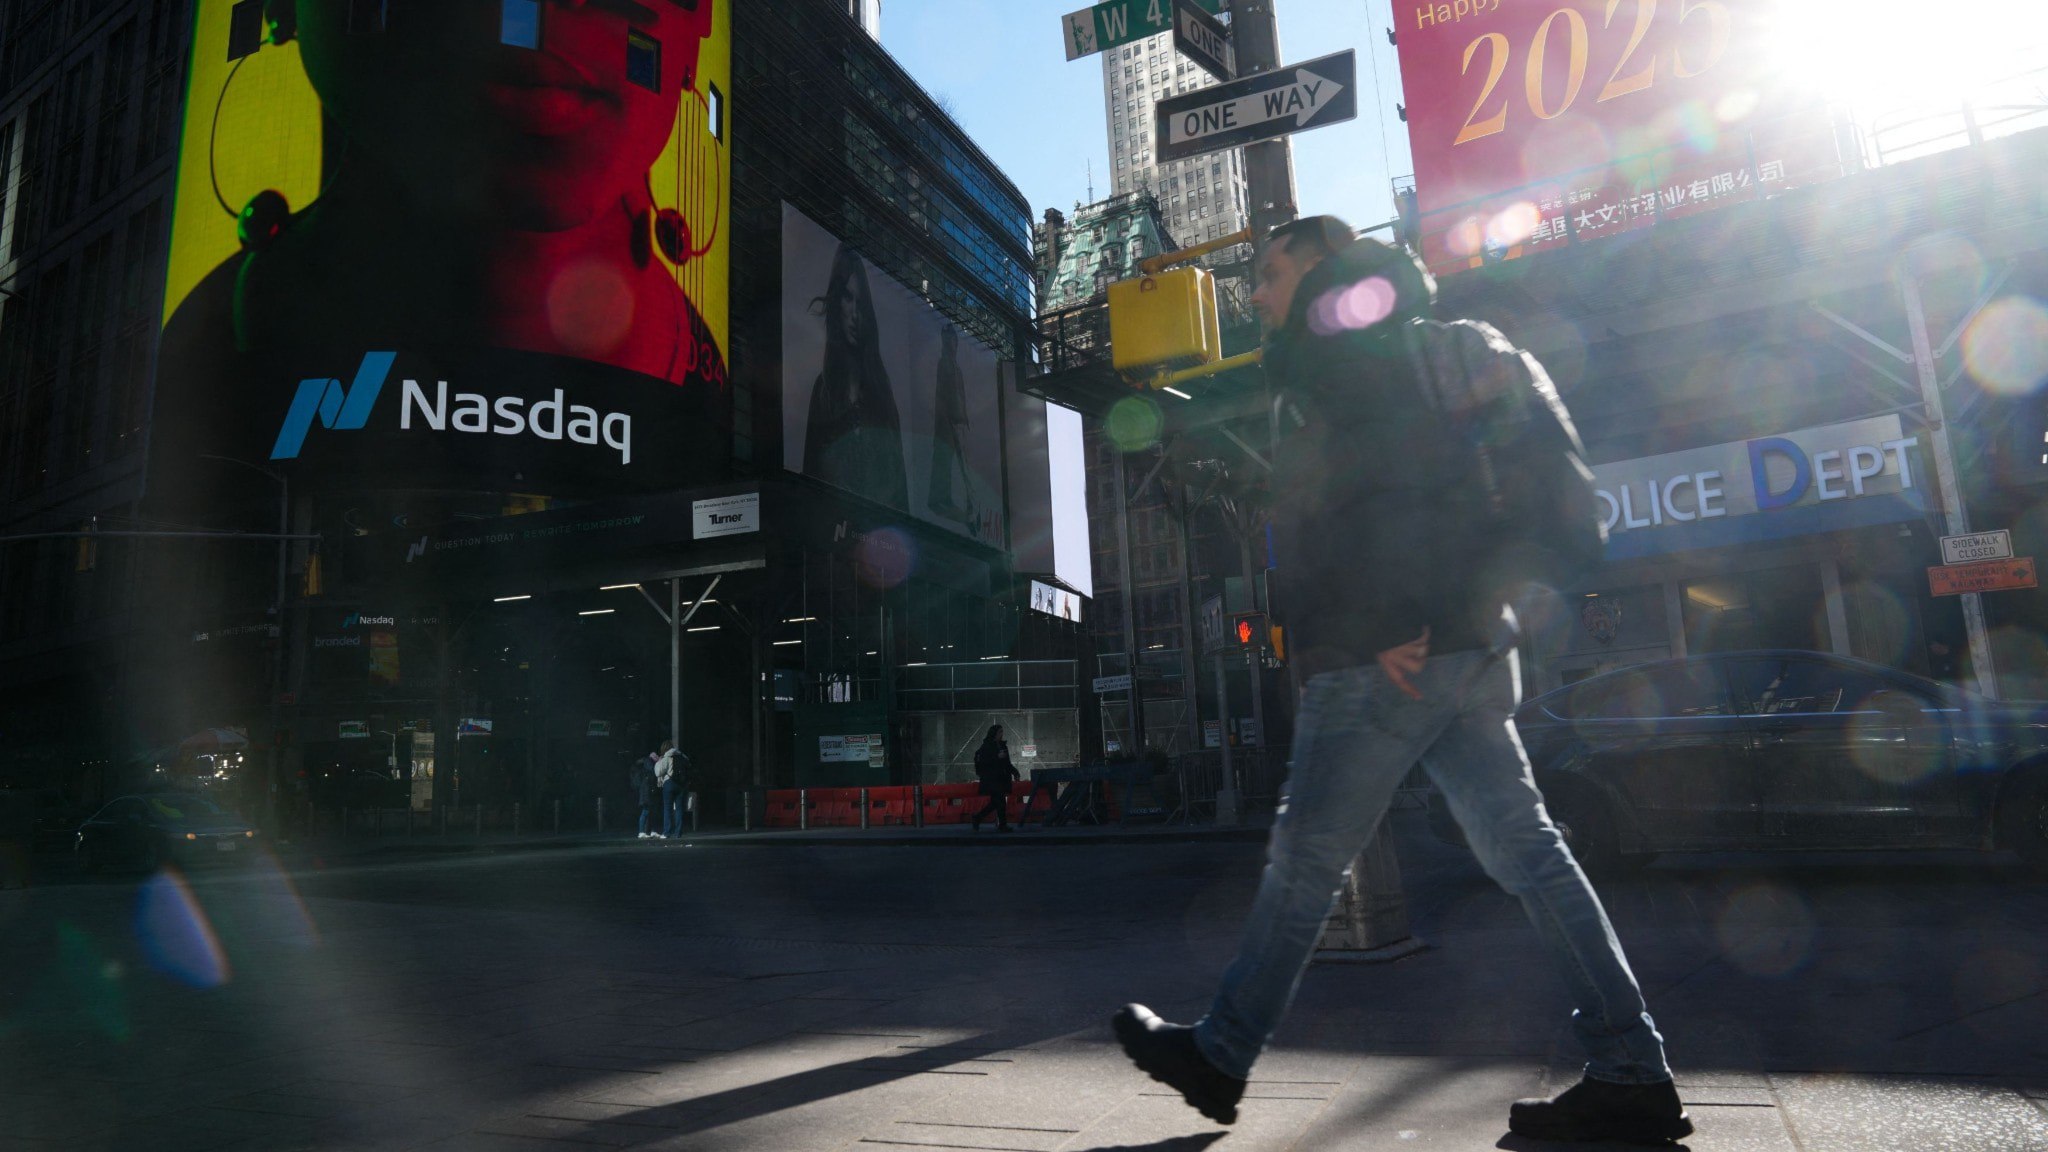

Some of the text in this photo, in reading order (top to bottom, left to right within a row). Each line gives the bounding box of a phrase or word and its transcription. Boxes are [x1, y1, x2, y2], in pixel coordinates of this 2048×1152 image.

[1101, 0, 1173, 42] W 4
[1190, 21, 1222, 59] ONE
[1453, 0, 1731, 145] 2025
[1184, 80, 1322, 137] ONE WAY
[401, 379, 631, 465] Nasdaq
[1595, 437, 1919, 530] OLICE DEPT
[434, 516, 642, 550] QUESTION TODAY REWRITE TOMORROW
[709, 513, 743, 525] Turner
[1952, 536, 1999, 549] SIDEWALK
[1958, 547, 1996, 559] CLOSED
[359, 616, 394, 626] Nasdaq
[314, 636, 361, 647] branded
